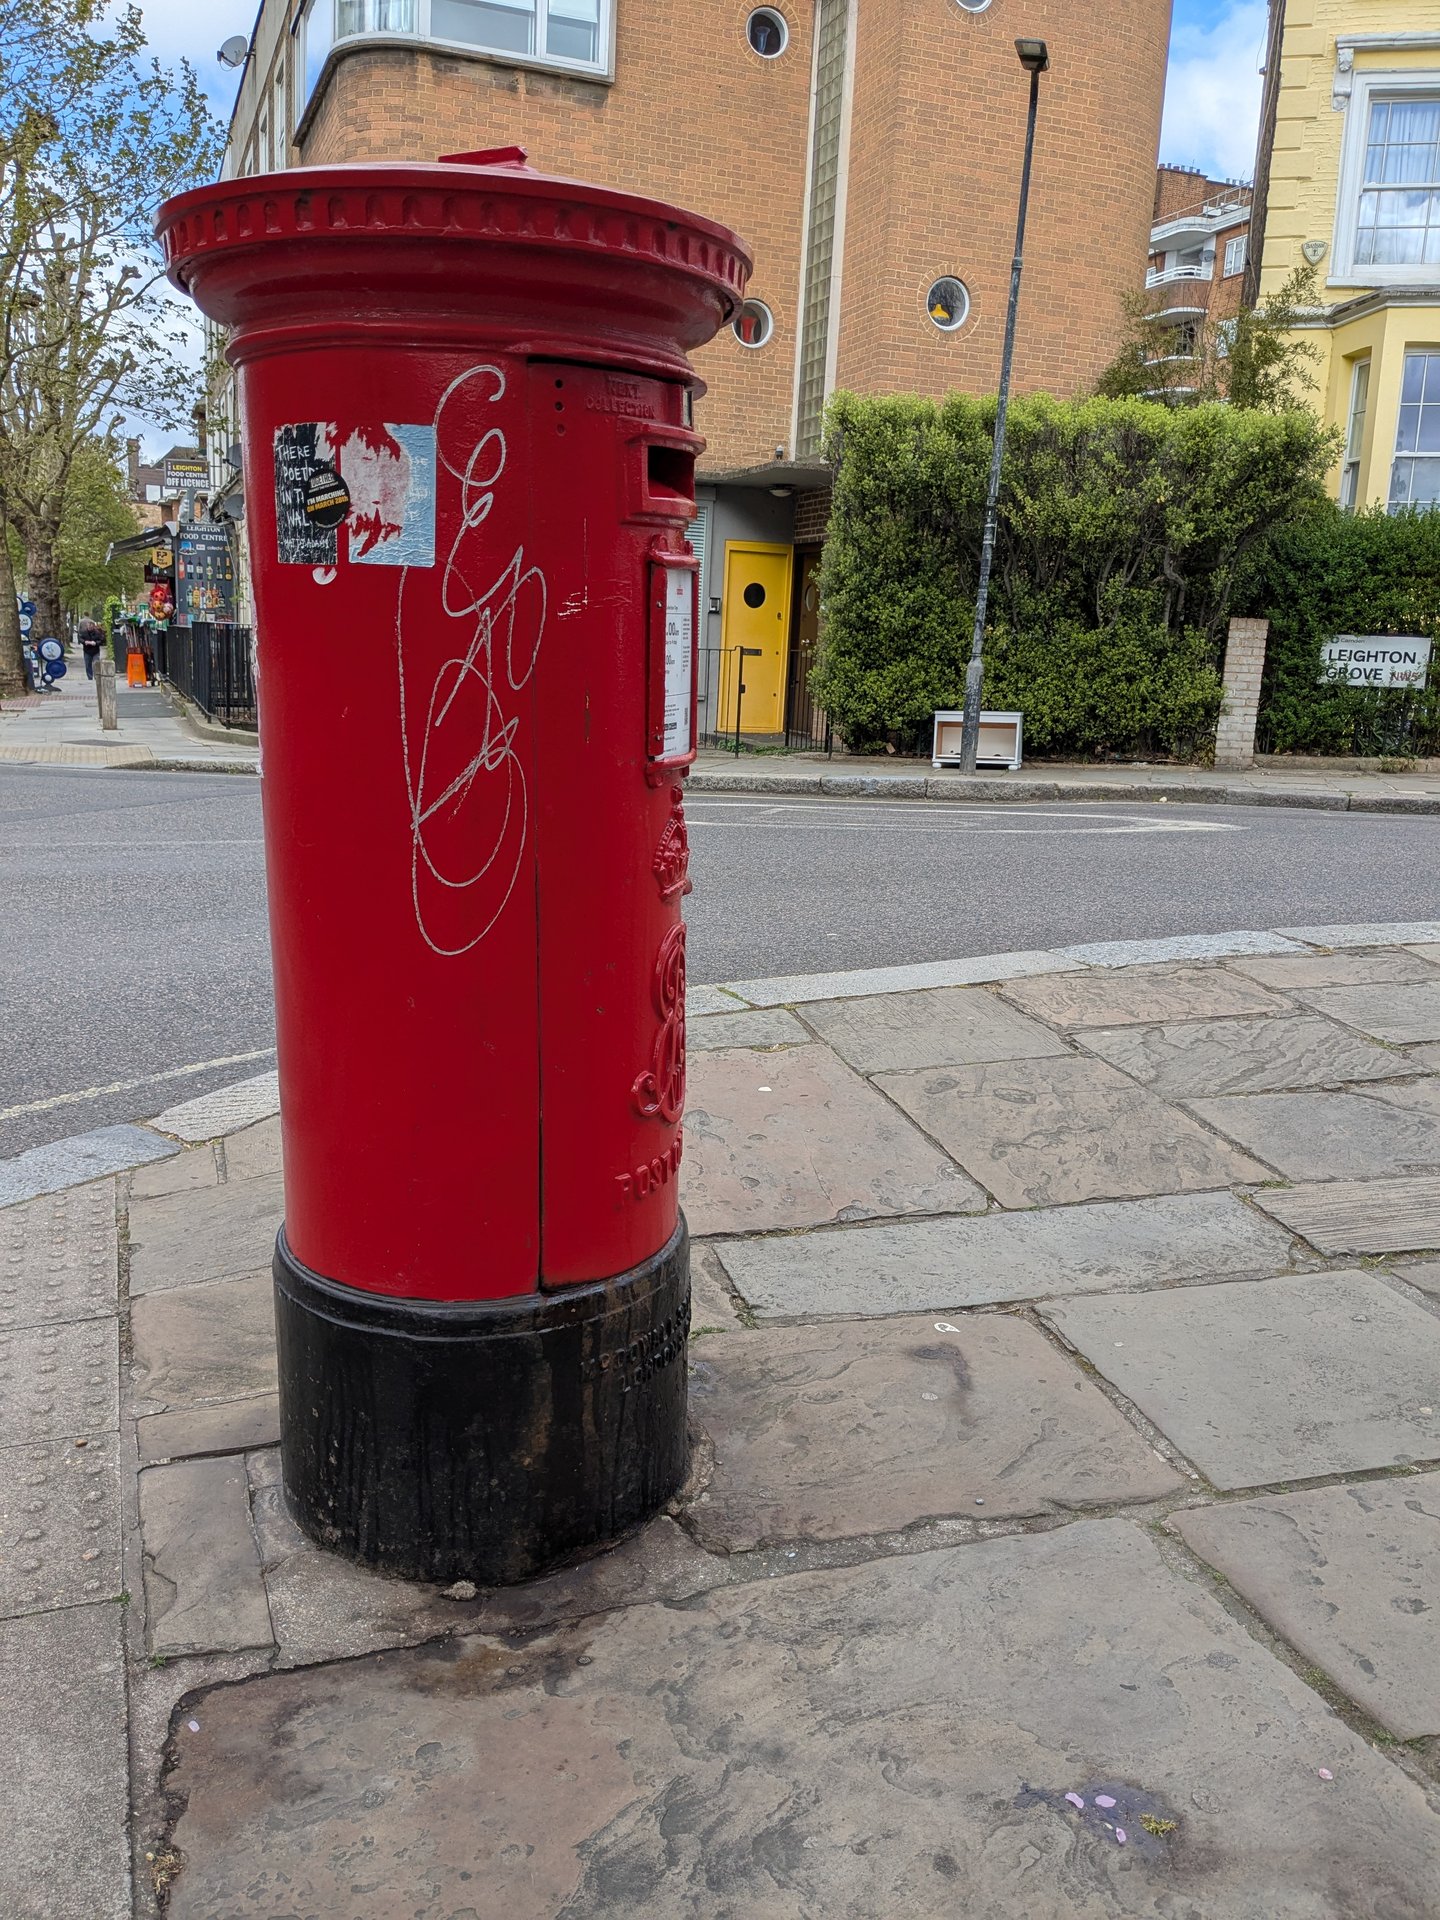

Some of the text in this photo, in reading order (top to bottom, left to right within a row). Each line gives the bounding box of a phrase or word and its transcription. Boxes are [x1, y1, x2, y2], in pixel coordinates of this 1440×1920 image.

[608, 380, 640, 399] NEXT
[584, 394, 656, 419] COLLECTION
[275, 444, 310, 461] THERE
[172, 464, 203, 472] LEIGHTON
[166, 477, 210, 488] OFF LICENCE
[315, 488, 346, 502] MARCHING
[315, 499, 335, 510] MARCH
[179, 532, 227, 542] FOOD CENTRE
[1328, 649, 1417, 664] LEIGHTON
[1325, 666, 1419, 682] GROVE NW5
